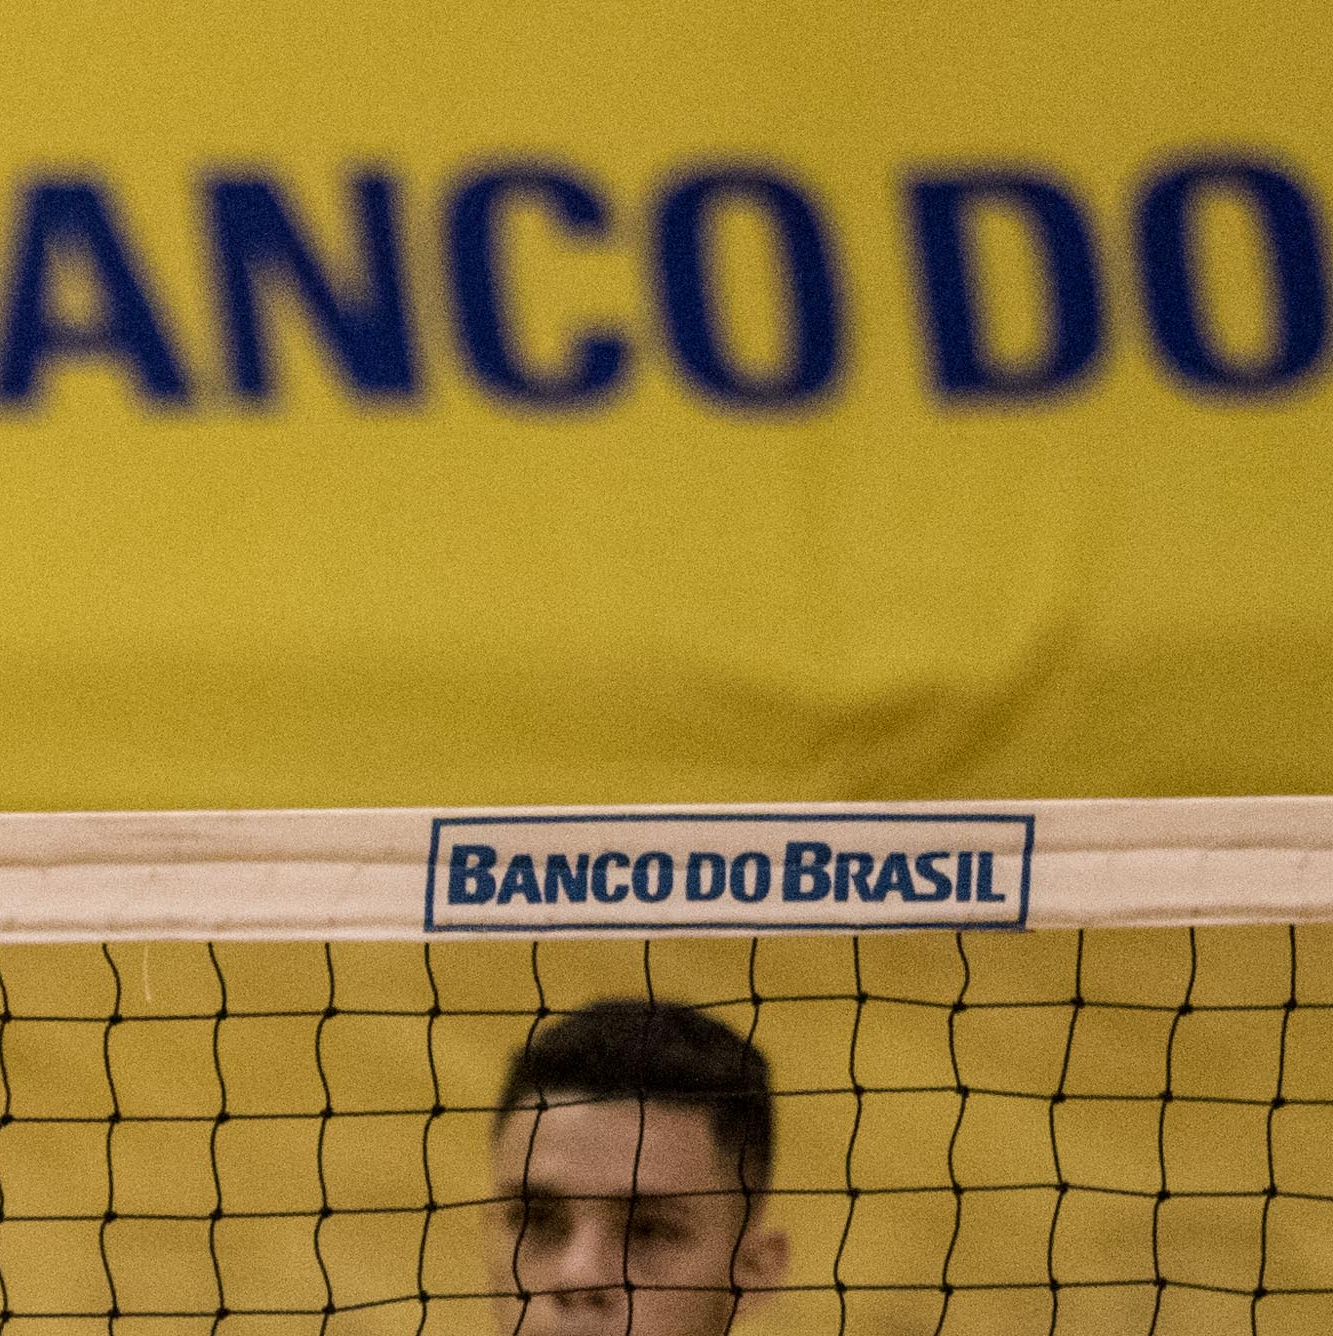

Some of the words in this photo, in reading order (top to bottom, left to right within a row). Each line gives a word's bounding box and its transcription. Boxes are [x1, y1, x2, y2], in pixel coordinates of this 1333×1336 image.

[898, 145, 1333, 405] DO
[447, 844, 674, 905] BANCO
[685, 850, 771, 903] DO
[782, 840, 1006, 902] BRASIL
